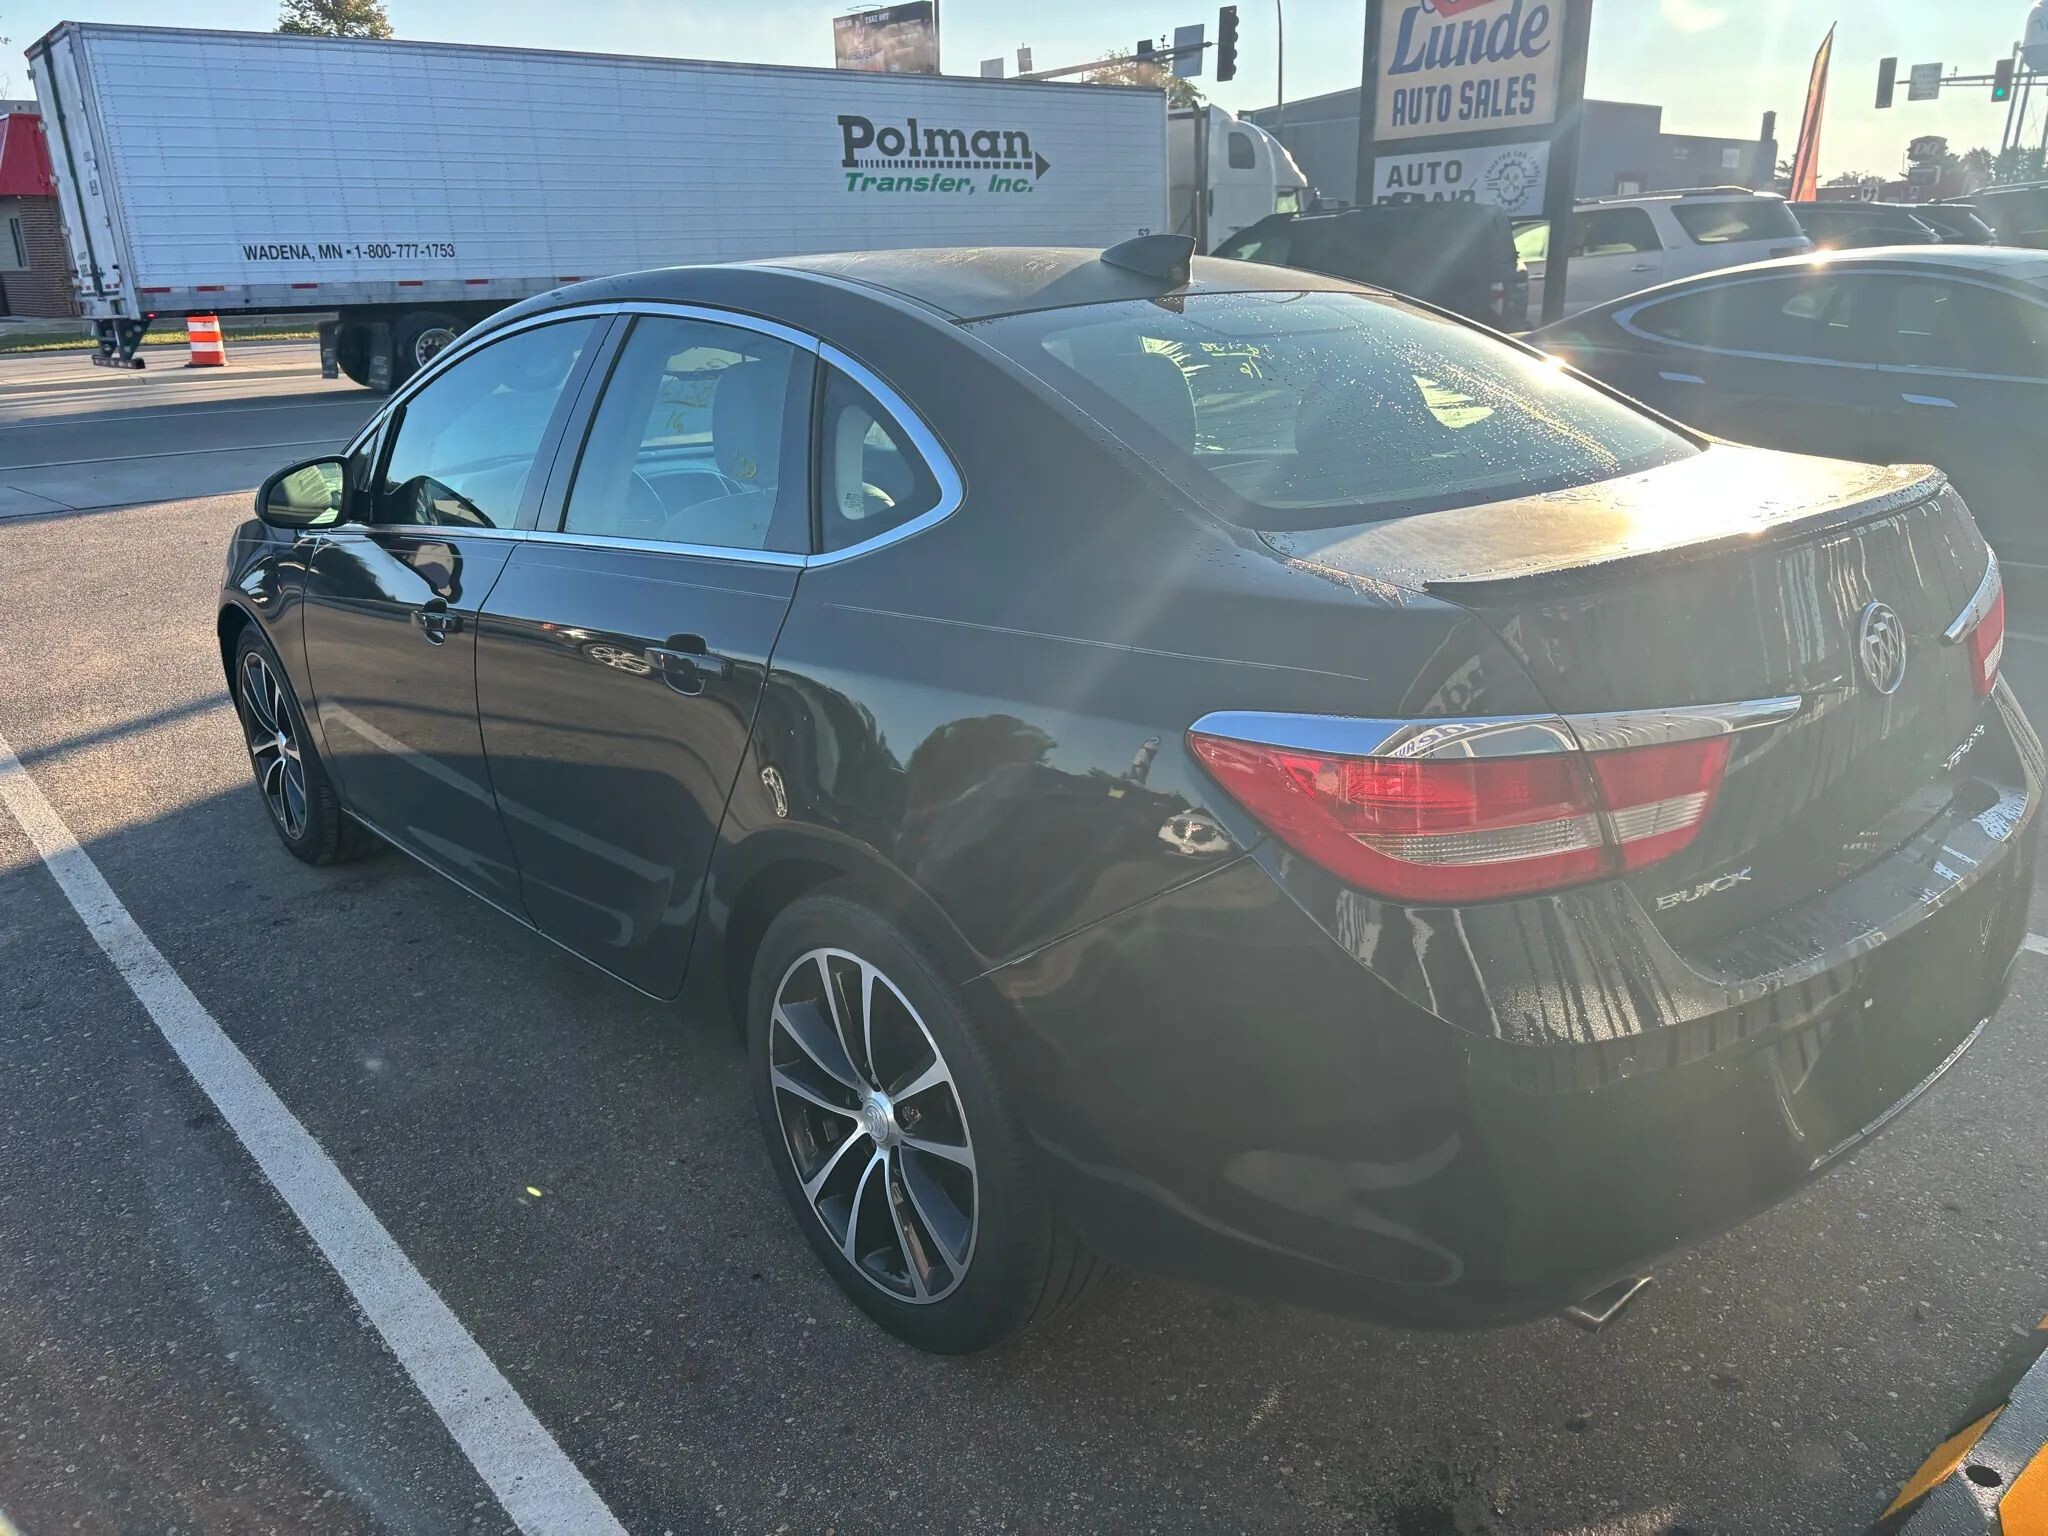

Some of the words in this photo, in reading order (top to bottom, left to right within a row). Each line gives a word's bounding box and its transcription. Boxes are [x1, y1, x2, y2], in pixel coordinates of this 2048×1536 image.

[1387, 0, 1551, 76] Lunde
[1391, 84, 1453, 128] AUTO
[1458, 73, 1537, 121] SALES
[837, 115, 1033, 168] Polman
[845, 172, 976, 195] Transfer,
[987, 174, 1034, 193] Inc.
[1386, 159, 1463, 189] AUTO
[243, 245, 316, 262] WADENA,
[318, 244, 343, 259] MN
[354, 243, 455, 259] 1-800-777-1753
[1655, 866, 1752, 912] BUICK
